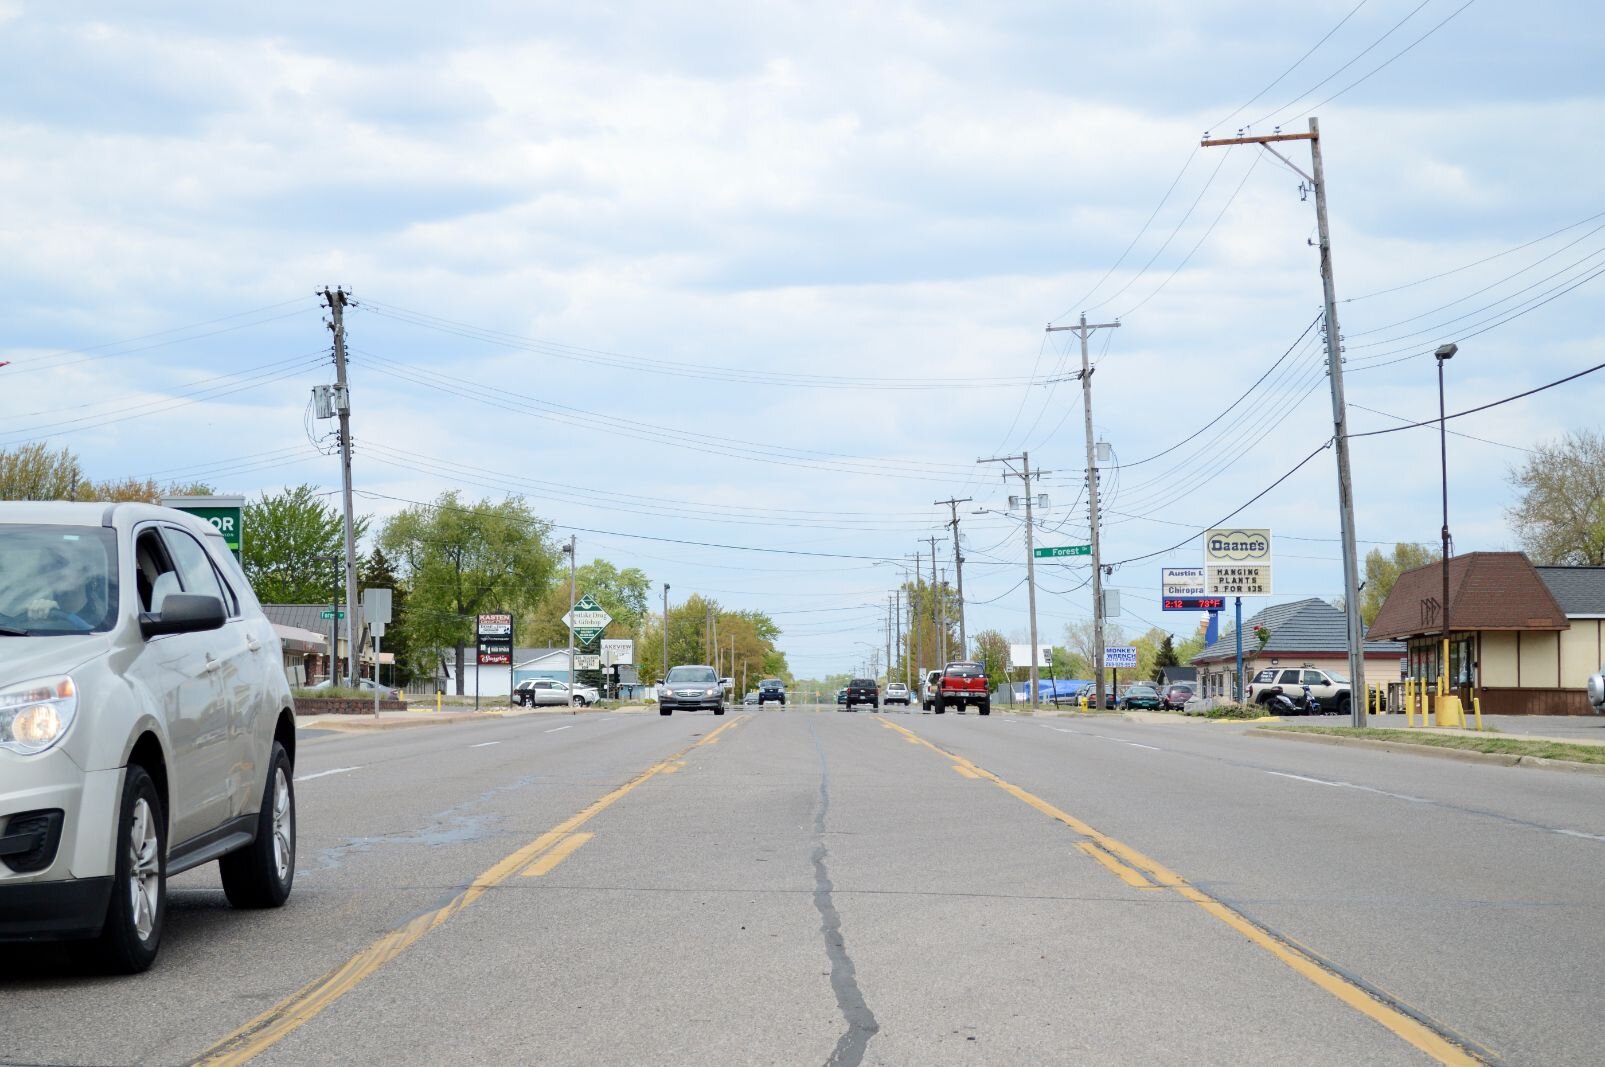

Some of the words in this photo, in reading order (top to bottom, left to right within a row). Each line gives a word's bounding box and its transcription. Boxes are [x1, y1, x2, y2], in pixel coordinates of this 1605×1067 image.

[1211, 539, 1265, 551] Daane's
[1052, 547, 1079, 556] Forest
[1217, 568, 1259, 576] HANGING
[1219, 577, 1257, 585] PLANTS
[1213, 585, 1219, 593] 3
[1224, 585, 1242, 593] FOR
[1247, 585, 1263, 593] $35
[1165, 600, 1183, 608] 2:12
